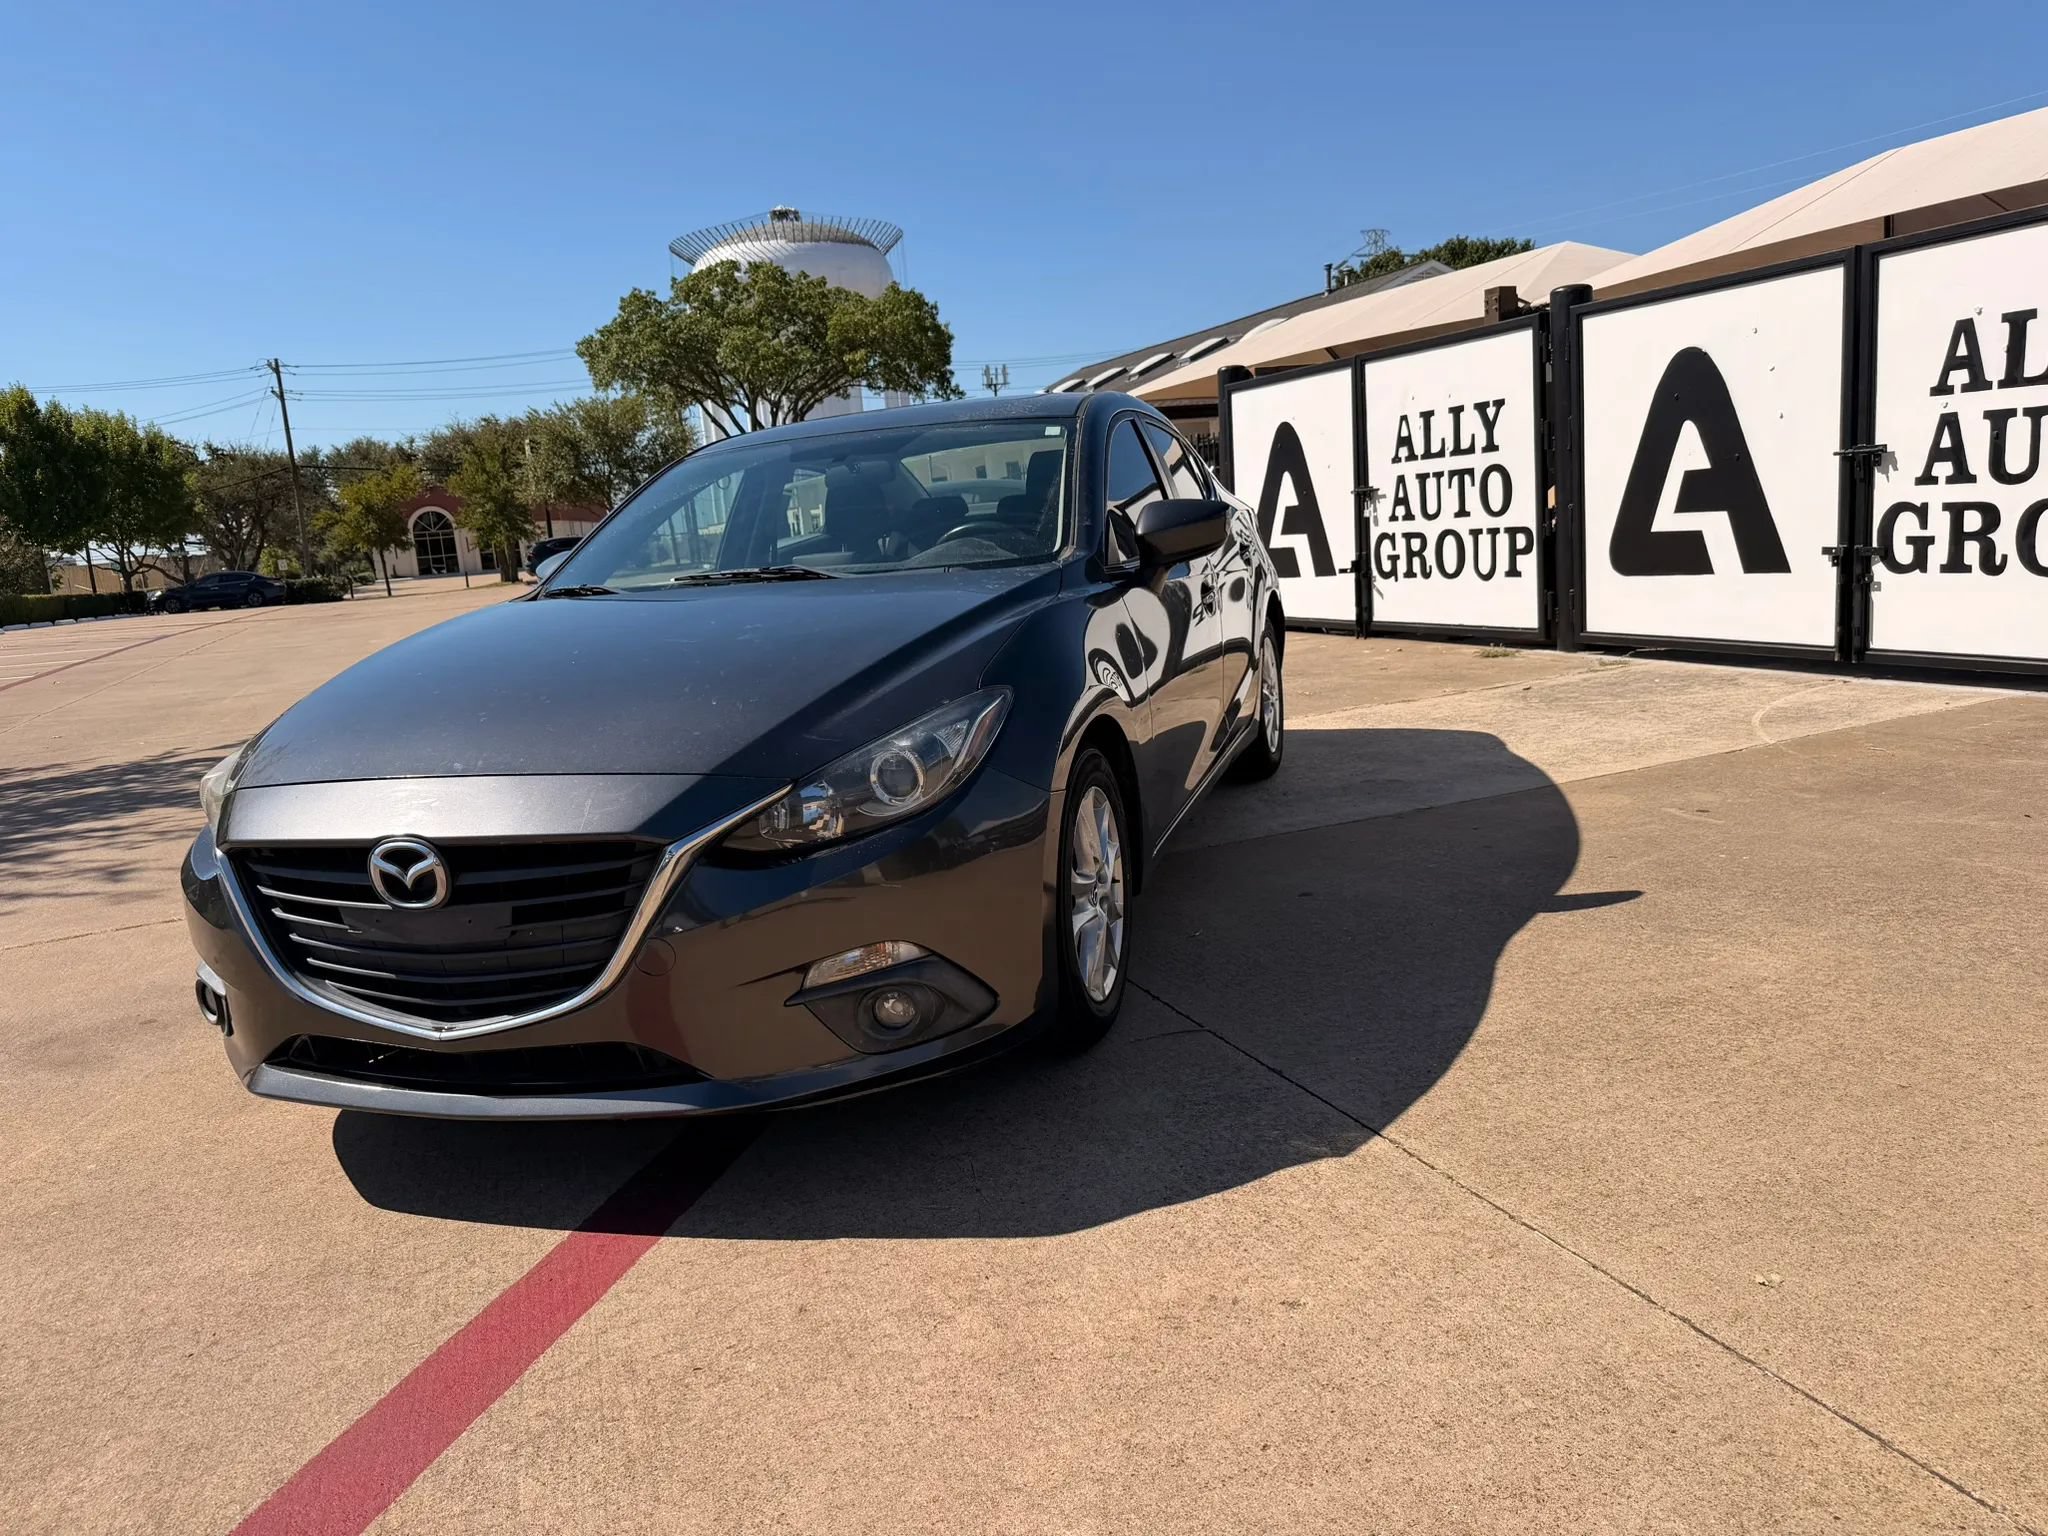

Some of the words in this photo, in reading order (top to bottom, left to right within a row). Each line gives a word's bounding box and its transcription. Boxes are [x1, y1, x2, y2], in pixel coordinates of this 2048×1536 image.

[1391, 397, 1506, 464] ALLY
[1609, 346, 1792, 576] A
[1257, 421, 1337, 578] A
[1388, 463, 1513, 523] AUTO
[1373, 526, 1535, 582] GROUP
